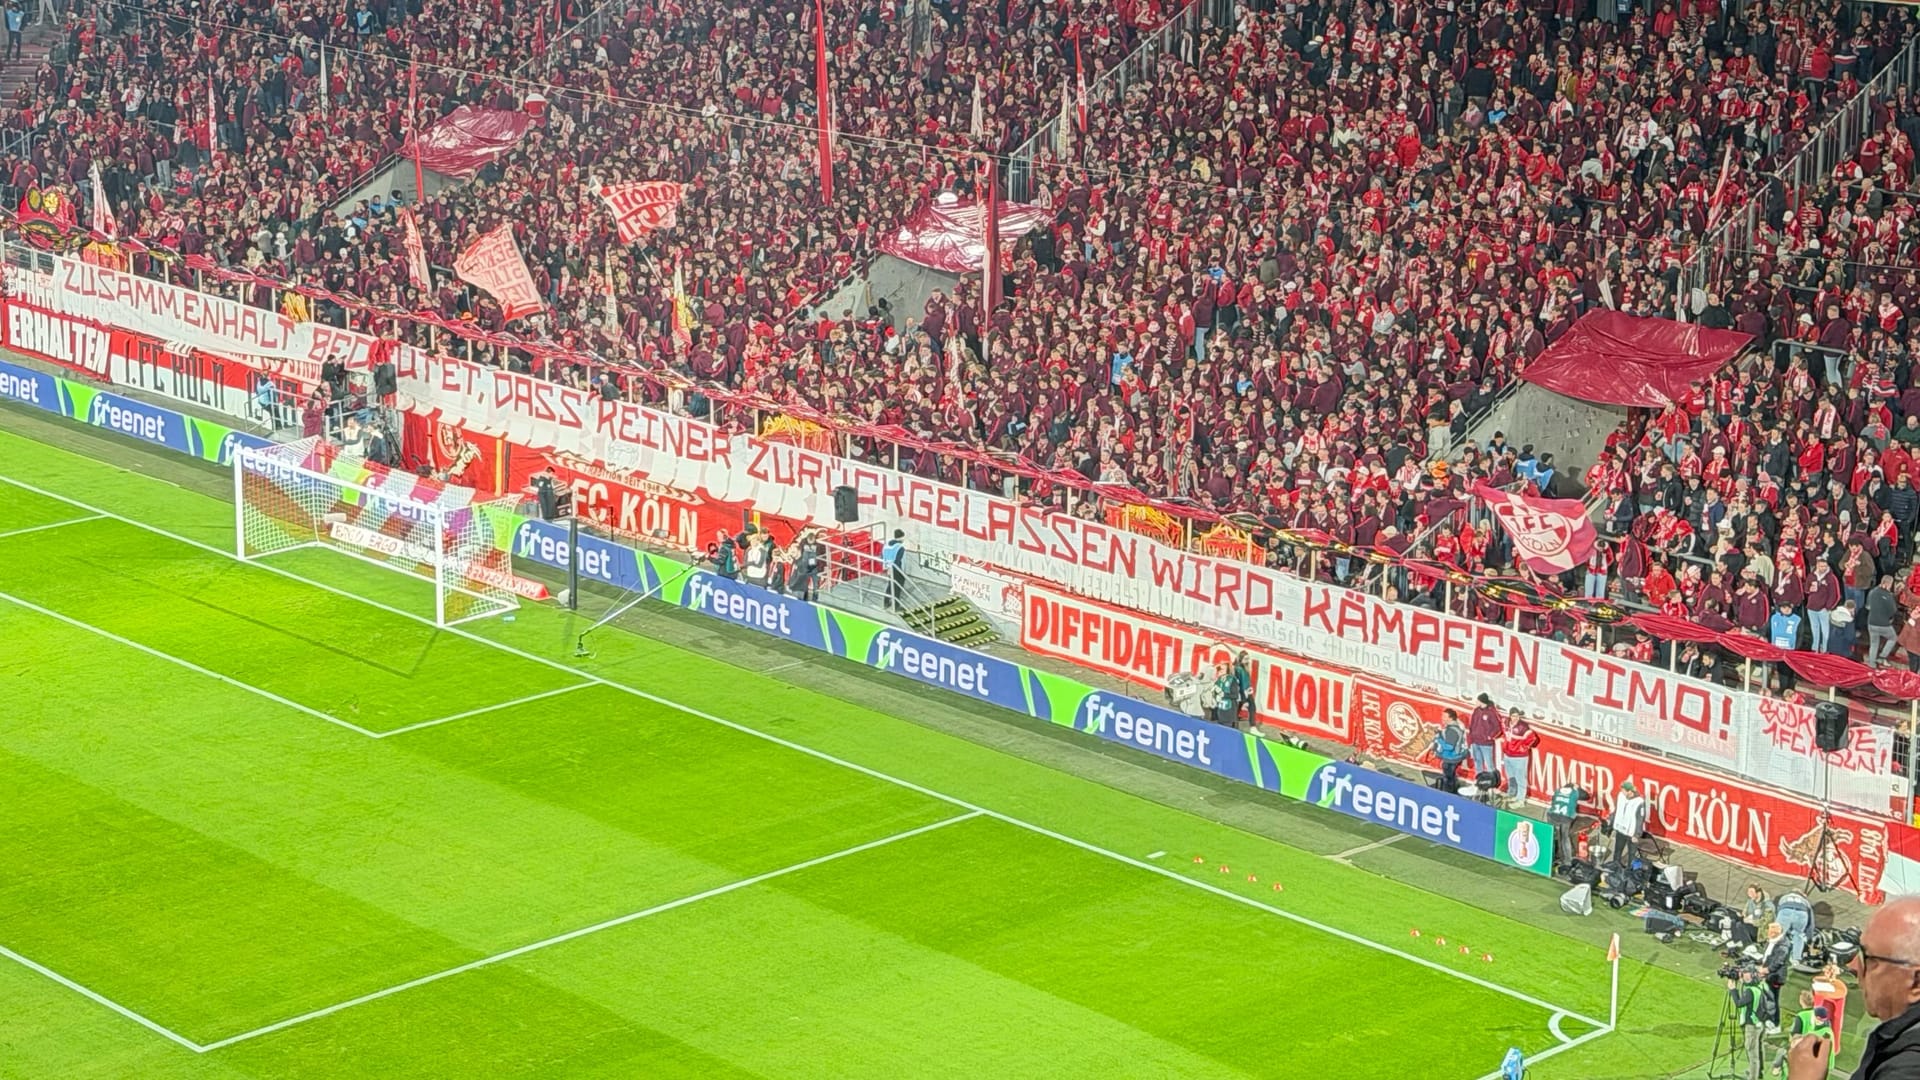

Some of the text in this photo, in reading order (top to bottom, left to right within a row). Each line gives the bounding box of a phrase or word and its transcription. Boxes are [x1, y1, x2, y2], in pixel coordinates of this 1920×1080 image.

[8, 303, 111, 375] ERHALTEN
[93, 396, 166, 442] freenet
[62, 260, 297, 350] ZUSAMMENHALT
[308, 327, 485, 404] BEDUTET,
[494, 372, 582, 429] DASS
[1150, 545, 1283, 621] WIRD.
[1304, 586, 1540, 686] KÄMPFEN
[1561, 648, 1734, 741] TIMO!
[620, 490, 699, 549] KÖLN
[689, 574, 792, 635] freenet
[1029, 594, 1183, 681] DIFFIDATI
[876, 630, 988, 697] freenet
[1085, 694, 1212, 766] freenet
[1319, 765, 1462, 844] freenet
[1530, 747, 1616, 814] MMER
[1685, 786, 1772, 858] KÖLN
